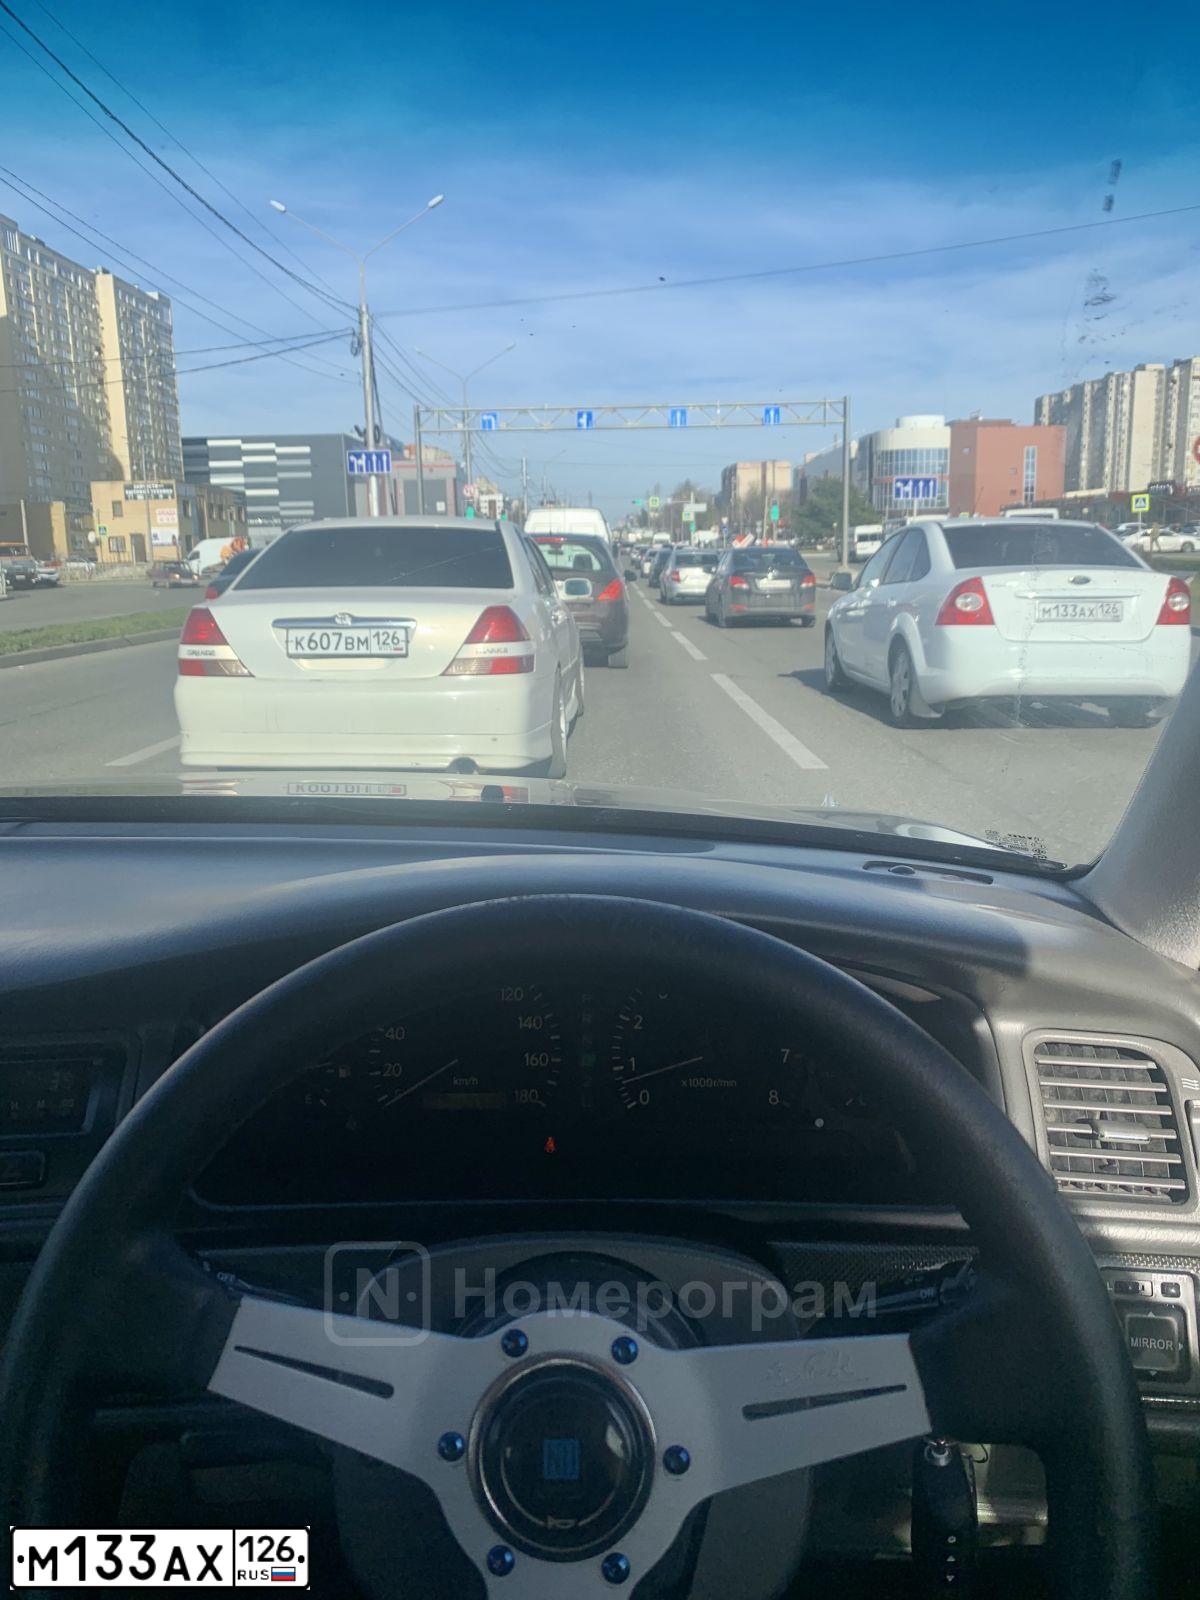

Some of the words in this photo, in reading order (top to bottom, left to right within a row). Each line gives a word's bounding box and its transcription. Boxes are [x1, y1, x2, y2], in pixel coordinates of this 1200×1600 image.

[1042, 604, 1095, 618] М133АХ
[1099, 603, 1119, 614] 126
[295, 632, 370, 651] К607ВМ
[372, 631, 401, 646] 126
[500, 986, 524, 1002] 120
[517, 1015, 543, 1030] 140
[633, 1016, 643, 1030] 2
[384, 1026, 406, 1041] 40
[523, 1051, 549, 1067] 160
[780, 1049, 791, 1063] 7
[382, 1062, 402, 1077] 20
[629, 1057, 637, 1071] 1
[513, 1088, 539, 1104] 180
[639, 1090, 650, 1104] 0
[768, 1090, 779, 1105] 8
[1130, 1337, 1174, 1351] MIRROR
